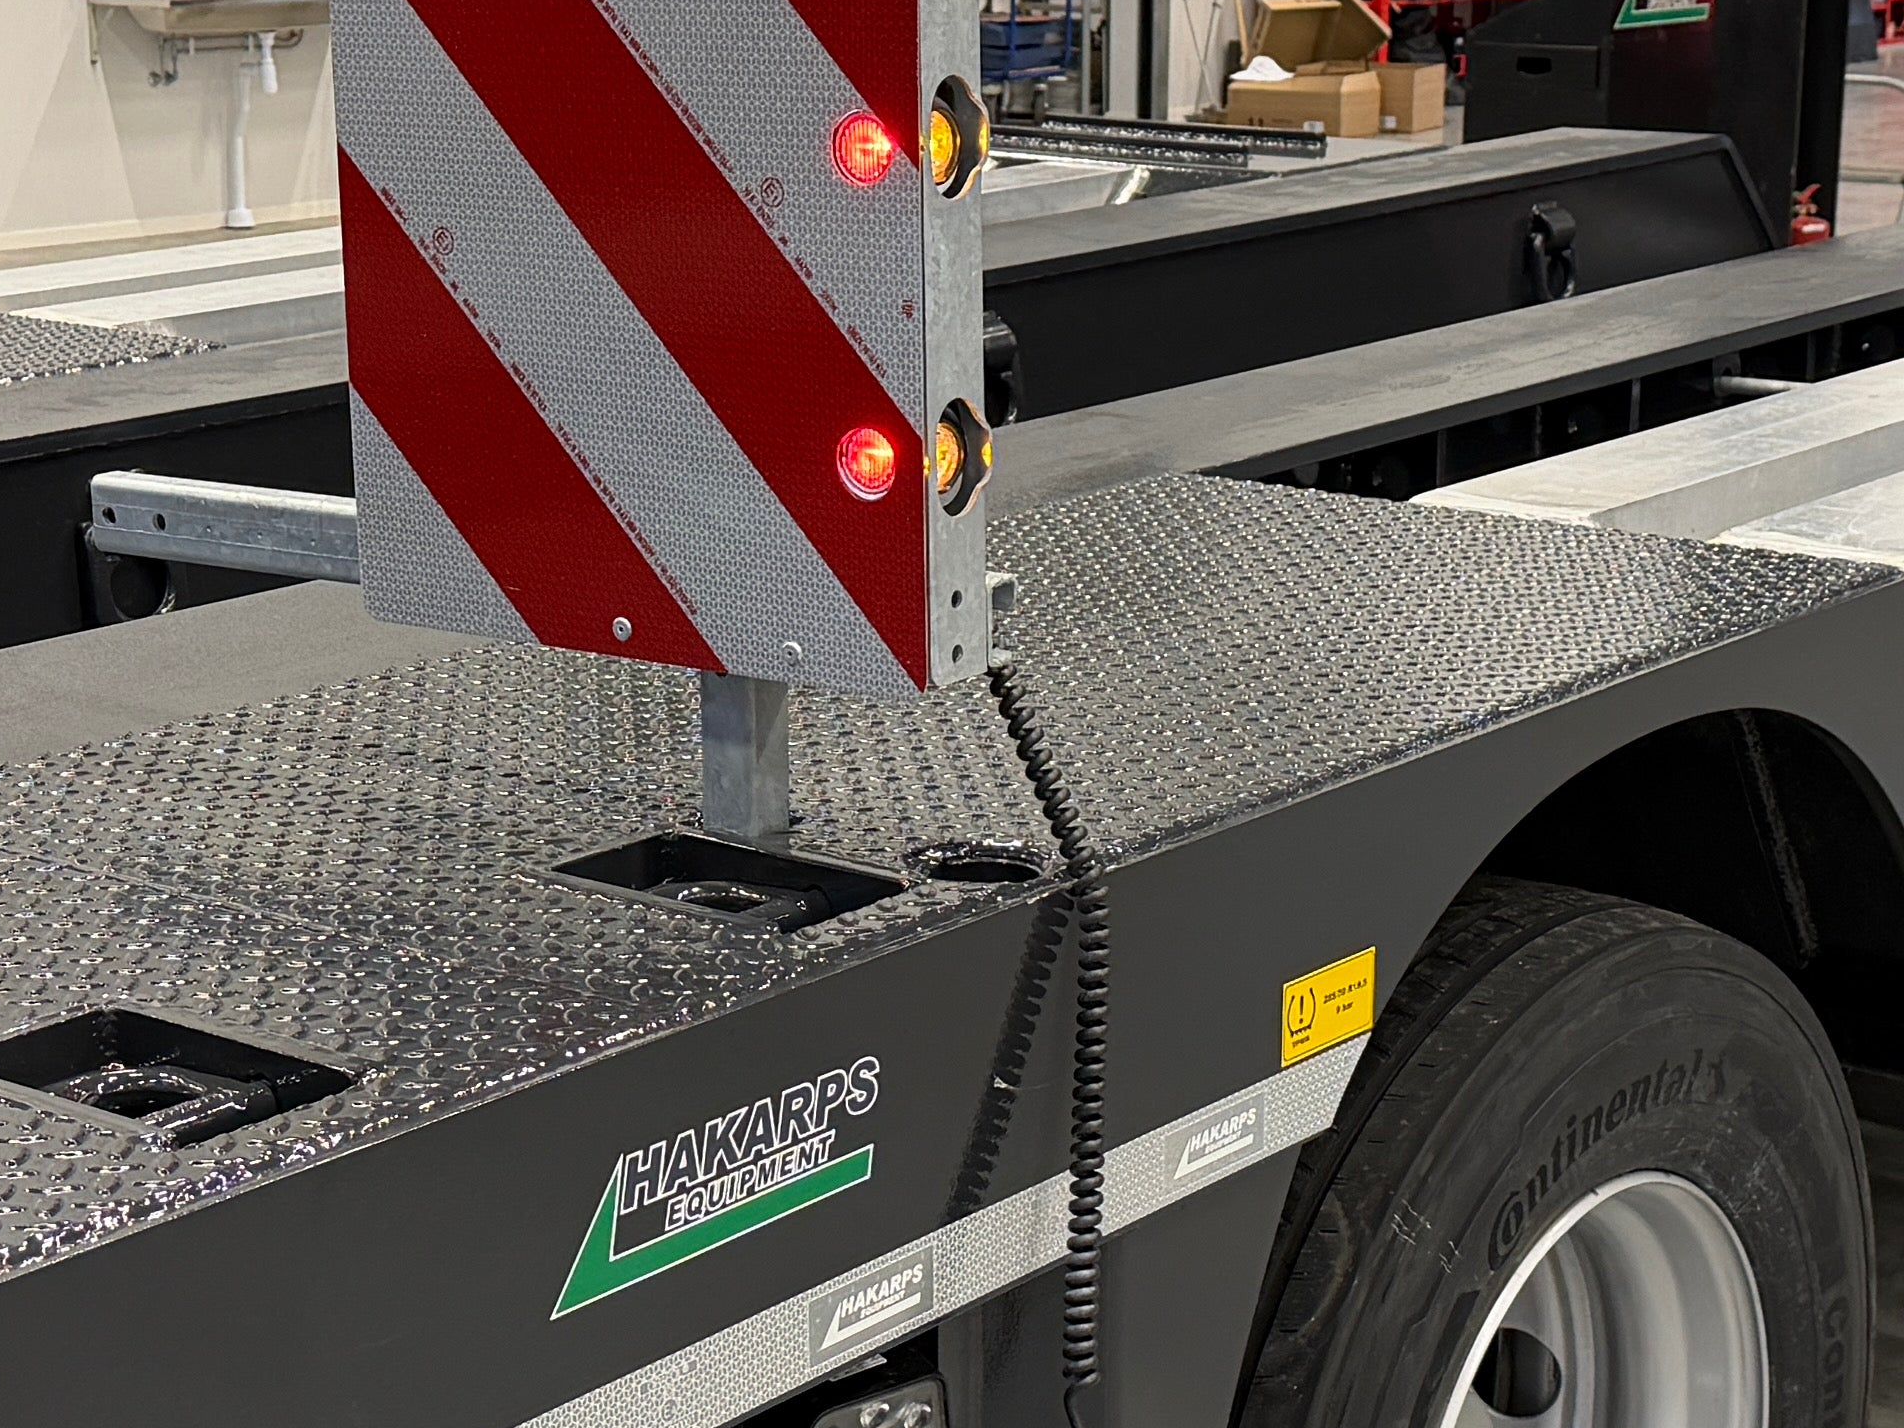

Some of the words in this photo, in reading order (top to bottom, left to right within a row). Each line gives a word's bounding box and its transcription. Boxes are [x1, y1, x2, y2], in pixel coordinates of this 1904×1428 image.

[619, 1055, 881, 1216] HAKARPS
[664, 1129, 836, 1232] EQUIPMENT
[1190, 1107, 1257, 1153] HAKARPS
[1487, 1048, 1705, 1272] Continental
[840, 1263, 924, 1319] HAKARPS
